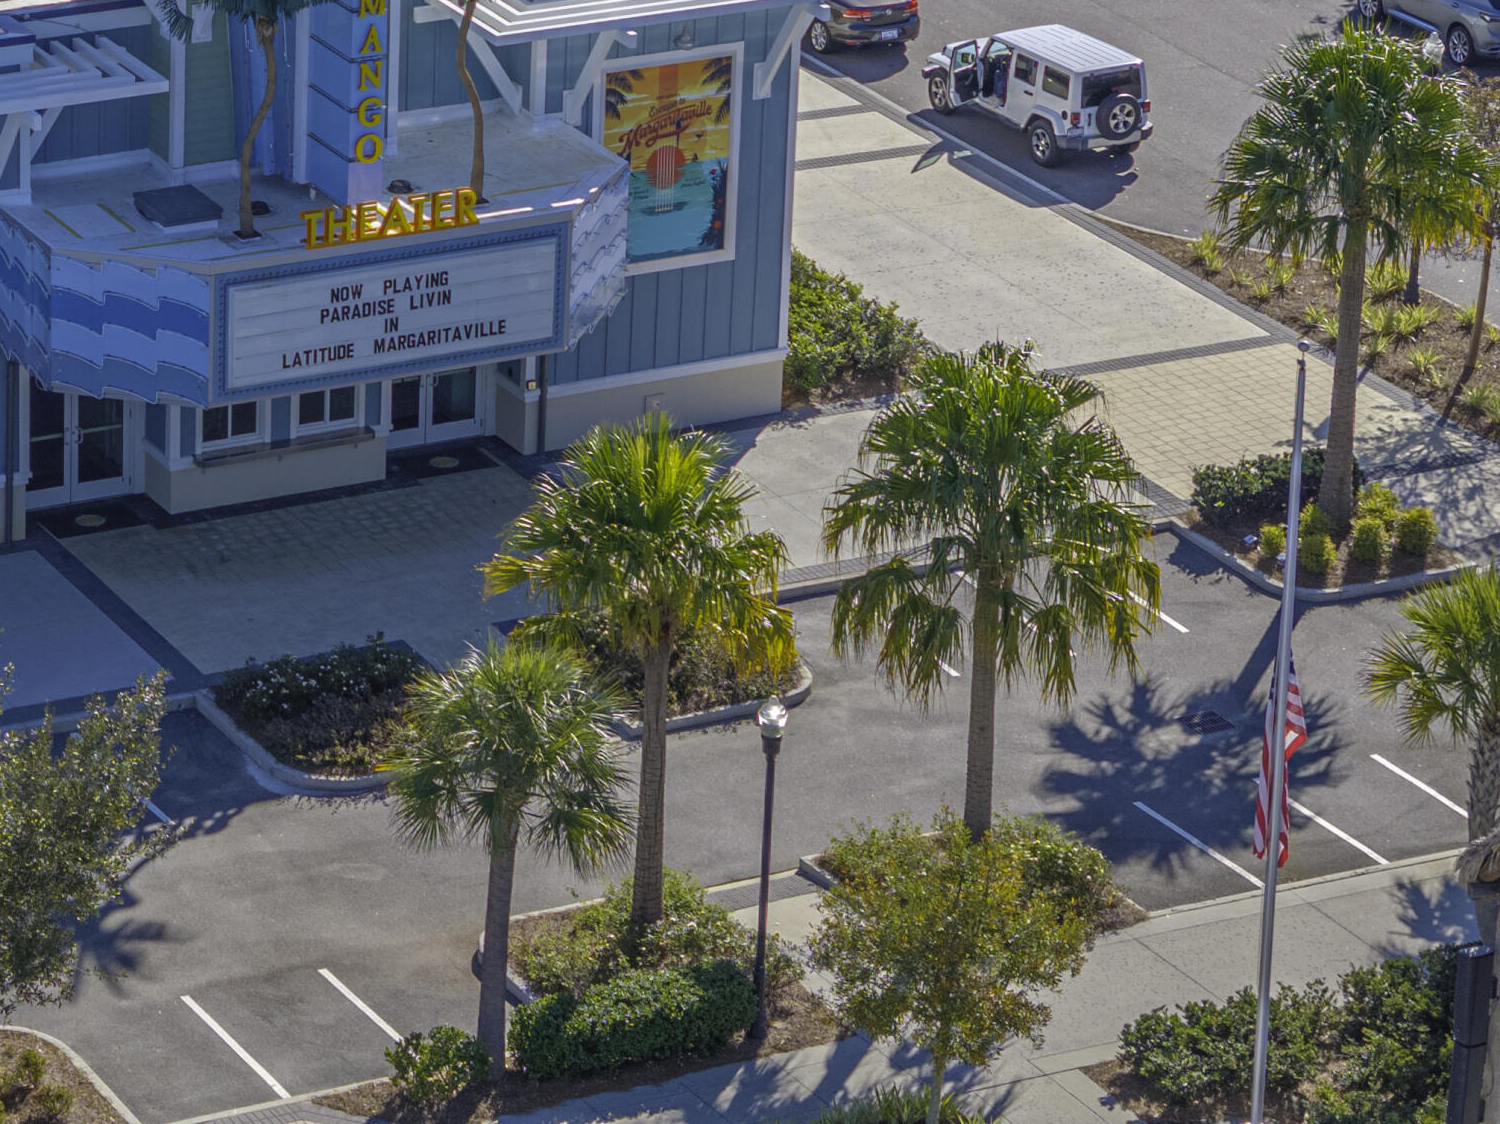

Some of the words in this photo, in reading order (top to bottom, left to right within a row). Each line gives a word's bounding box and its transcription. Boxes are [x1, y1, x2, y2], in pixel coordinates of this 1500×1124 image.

[301, 186, 480, 250] THEATER
[330, 283, 363, 304] NOW
[383, 271, 449, 295] PLAYING
[320, 298, 395, 324] PARADISE
[410, 289, 452, 311] LIVIN
[384, 316, 399, 334] IN
[282, 343, 354, 369] LATITUDE
[373, 319, 506, 354] MARGARITAVILLE
